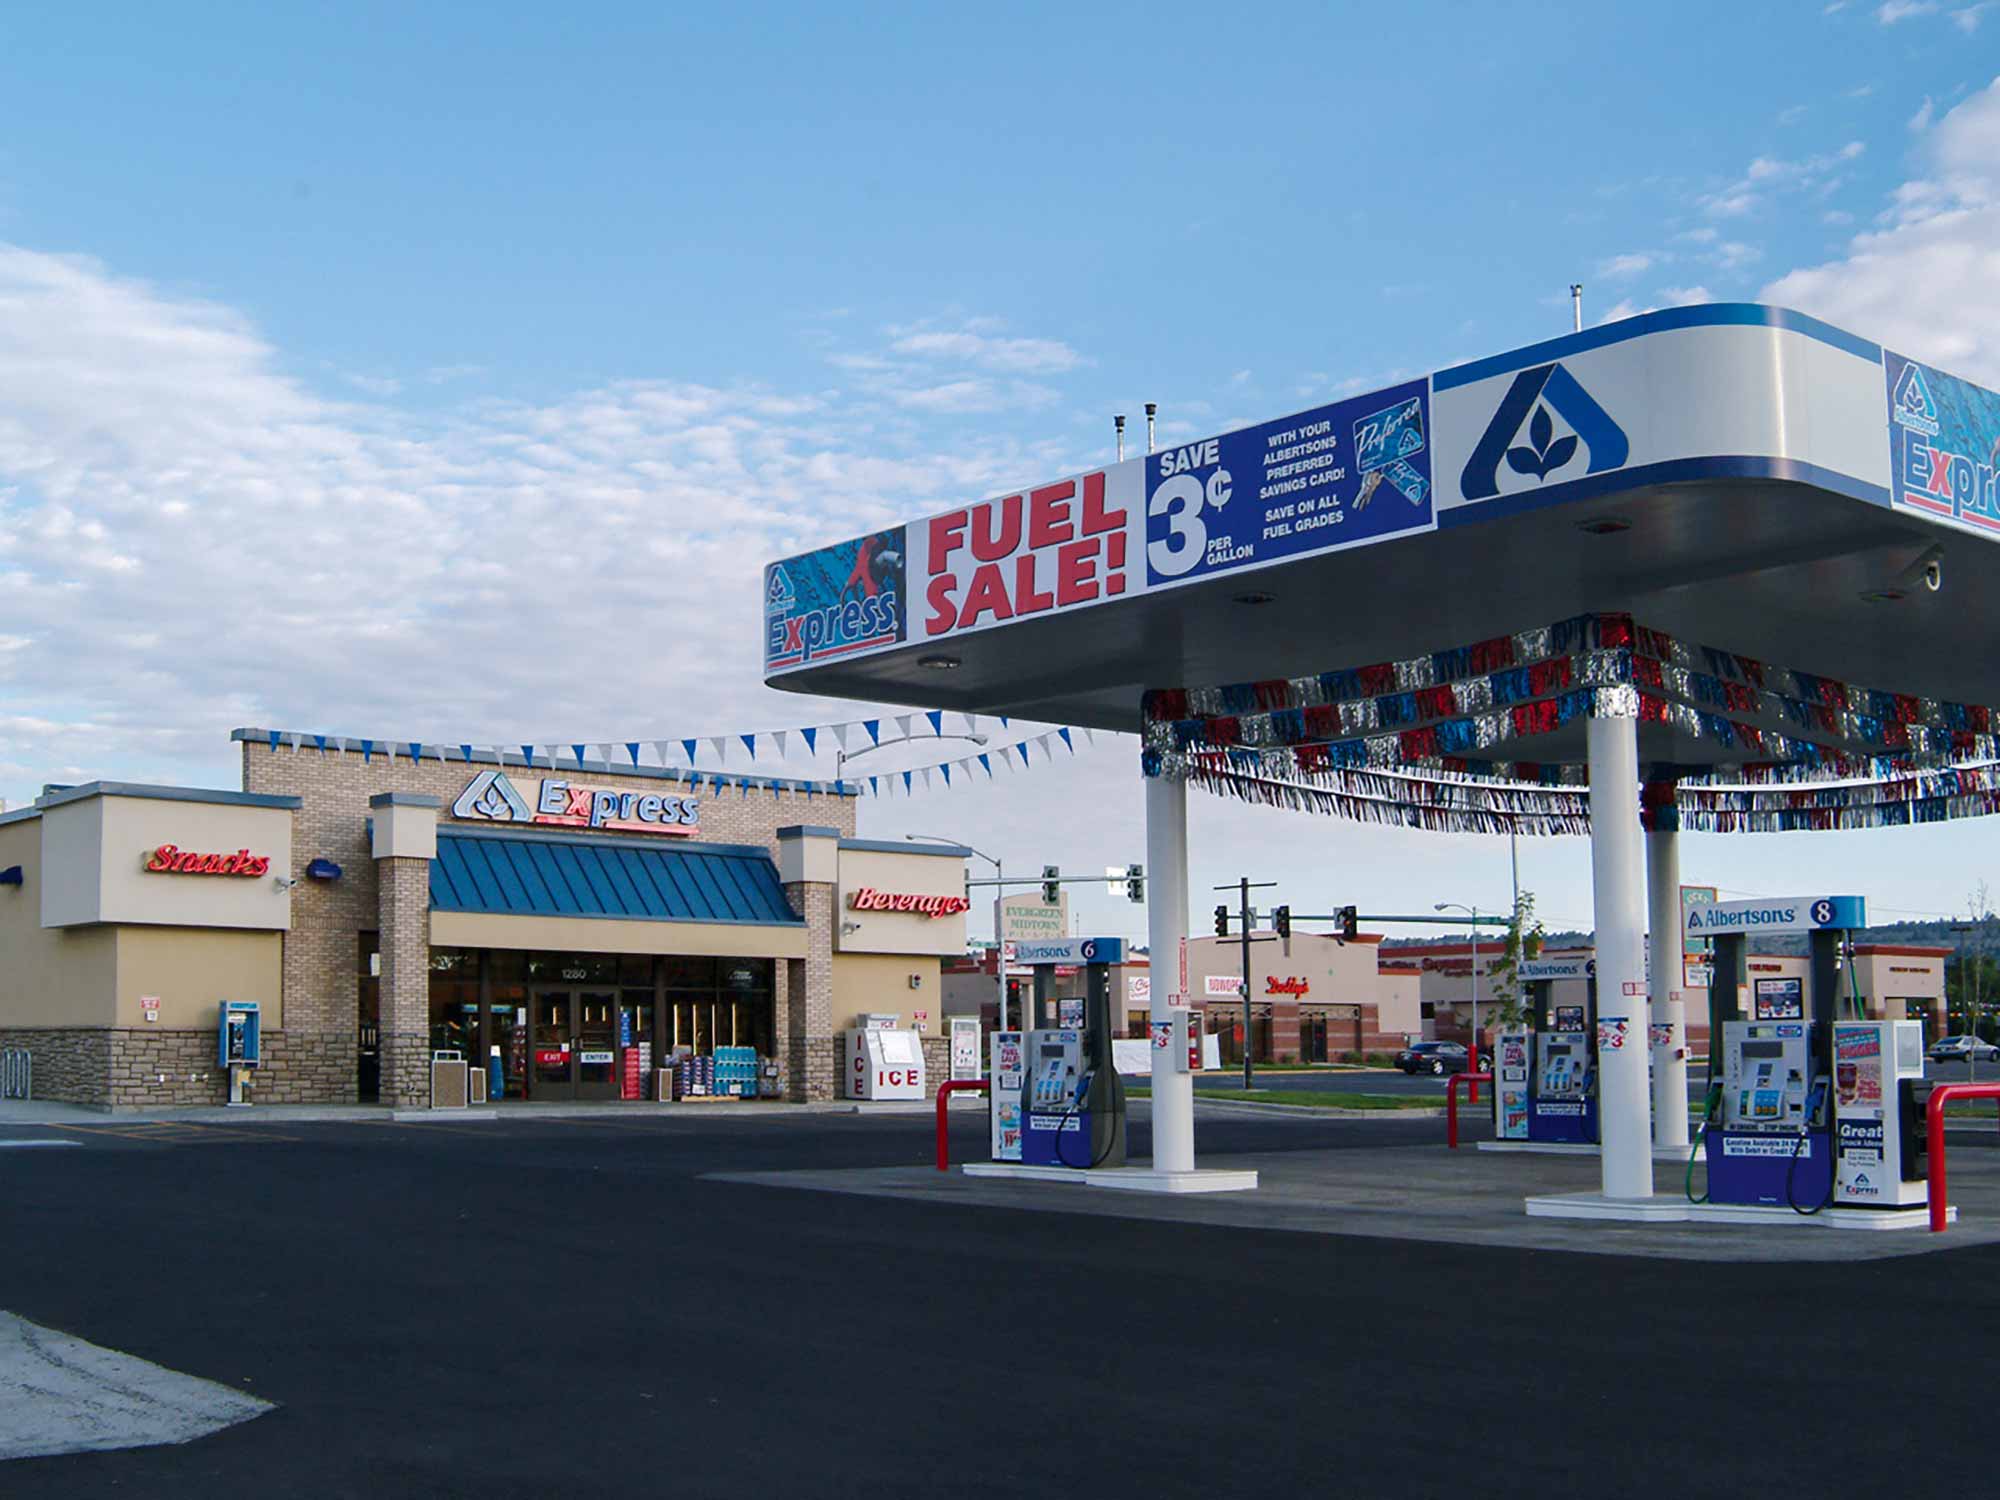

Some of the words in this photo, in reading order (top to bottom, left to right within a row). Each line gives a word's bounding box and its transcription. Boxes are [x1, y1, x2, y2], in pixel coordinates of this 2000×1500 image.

[1268, 430, 1296, 447] WITH
[1299, 421, 1331, 438] YOUR
[1160, 439, 1219, 477] SAVE
[1264, 436, 1337, 465] ALBERTSONS
[1267, 454, 1334, 480] PREFERRED
[1260, 477, 1307, 499] SAVINGS
[1310, 467, 1345, 486] CARD!
[1265, 505, 1295, 522] SAVE
[1298, 500, 1315, 514] ON
[1318, 494, 1340, 509] ALL
[928, 471, 1127, 576] FUEL
[1263, 523, 1293, 540] FUEL
[1296, 510, 1344, 532] GRADES
[1207, 544, 1254, 566] GALLON
[1208, 536, 1232, 552] PER
[925, 531, 1127, 636] SALE!
[767, 592, 897, 662] Express
[539, 778, 700, 828] Express
[148, 844, 270, 876] Snacks
[856, 888, 969, 919] Beverages
[1006, 907, 1063, 917] EVERGREEN
[1706, 907, 1796, 928] Albertsons
[1816, 903, 1831, 923] 8
[1010, 919, 1060, 930] MIDTOWN
[1084, 946, 1095, 957] 6
[562, 969, 586, 979] 1280
[881, 1021, 896, 1029] ICE
[854, 1035, 865, 1095] ICE
[879, 1069, 919, 1087] ICE
[1840, 1124, 1883, 1138] Great
[1846, 1185, 1879, 1195] Express
